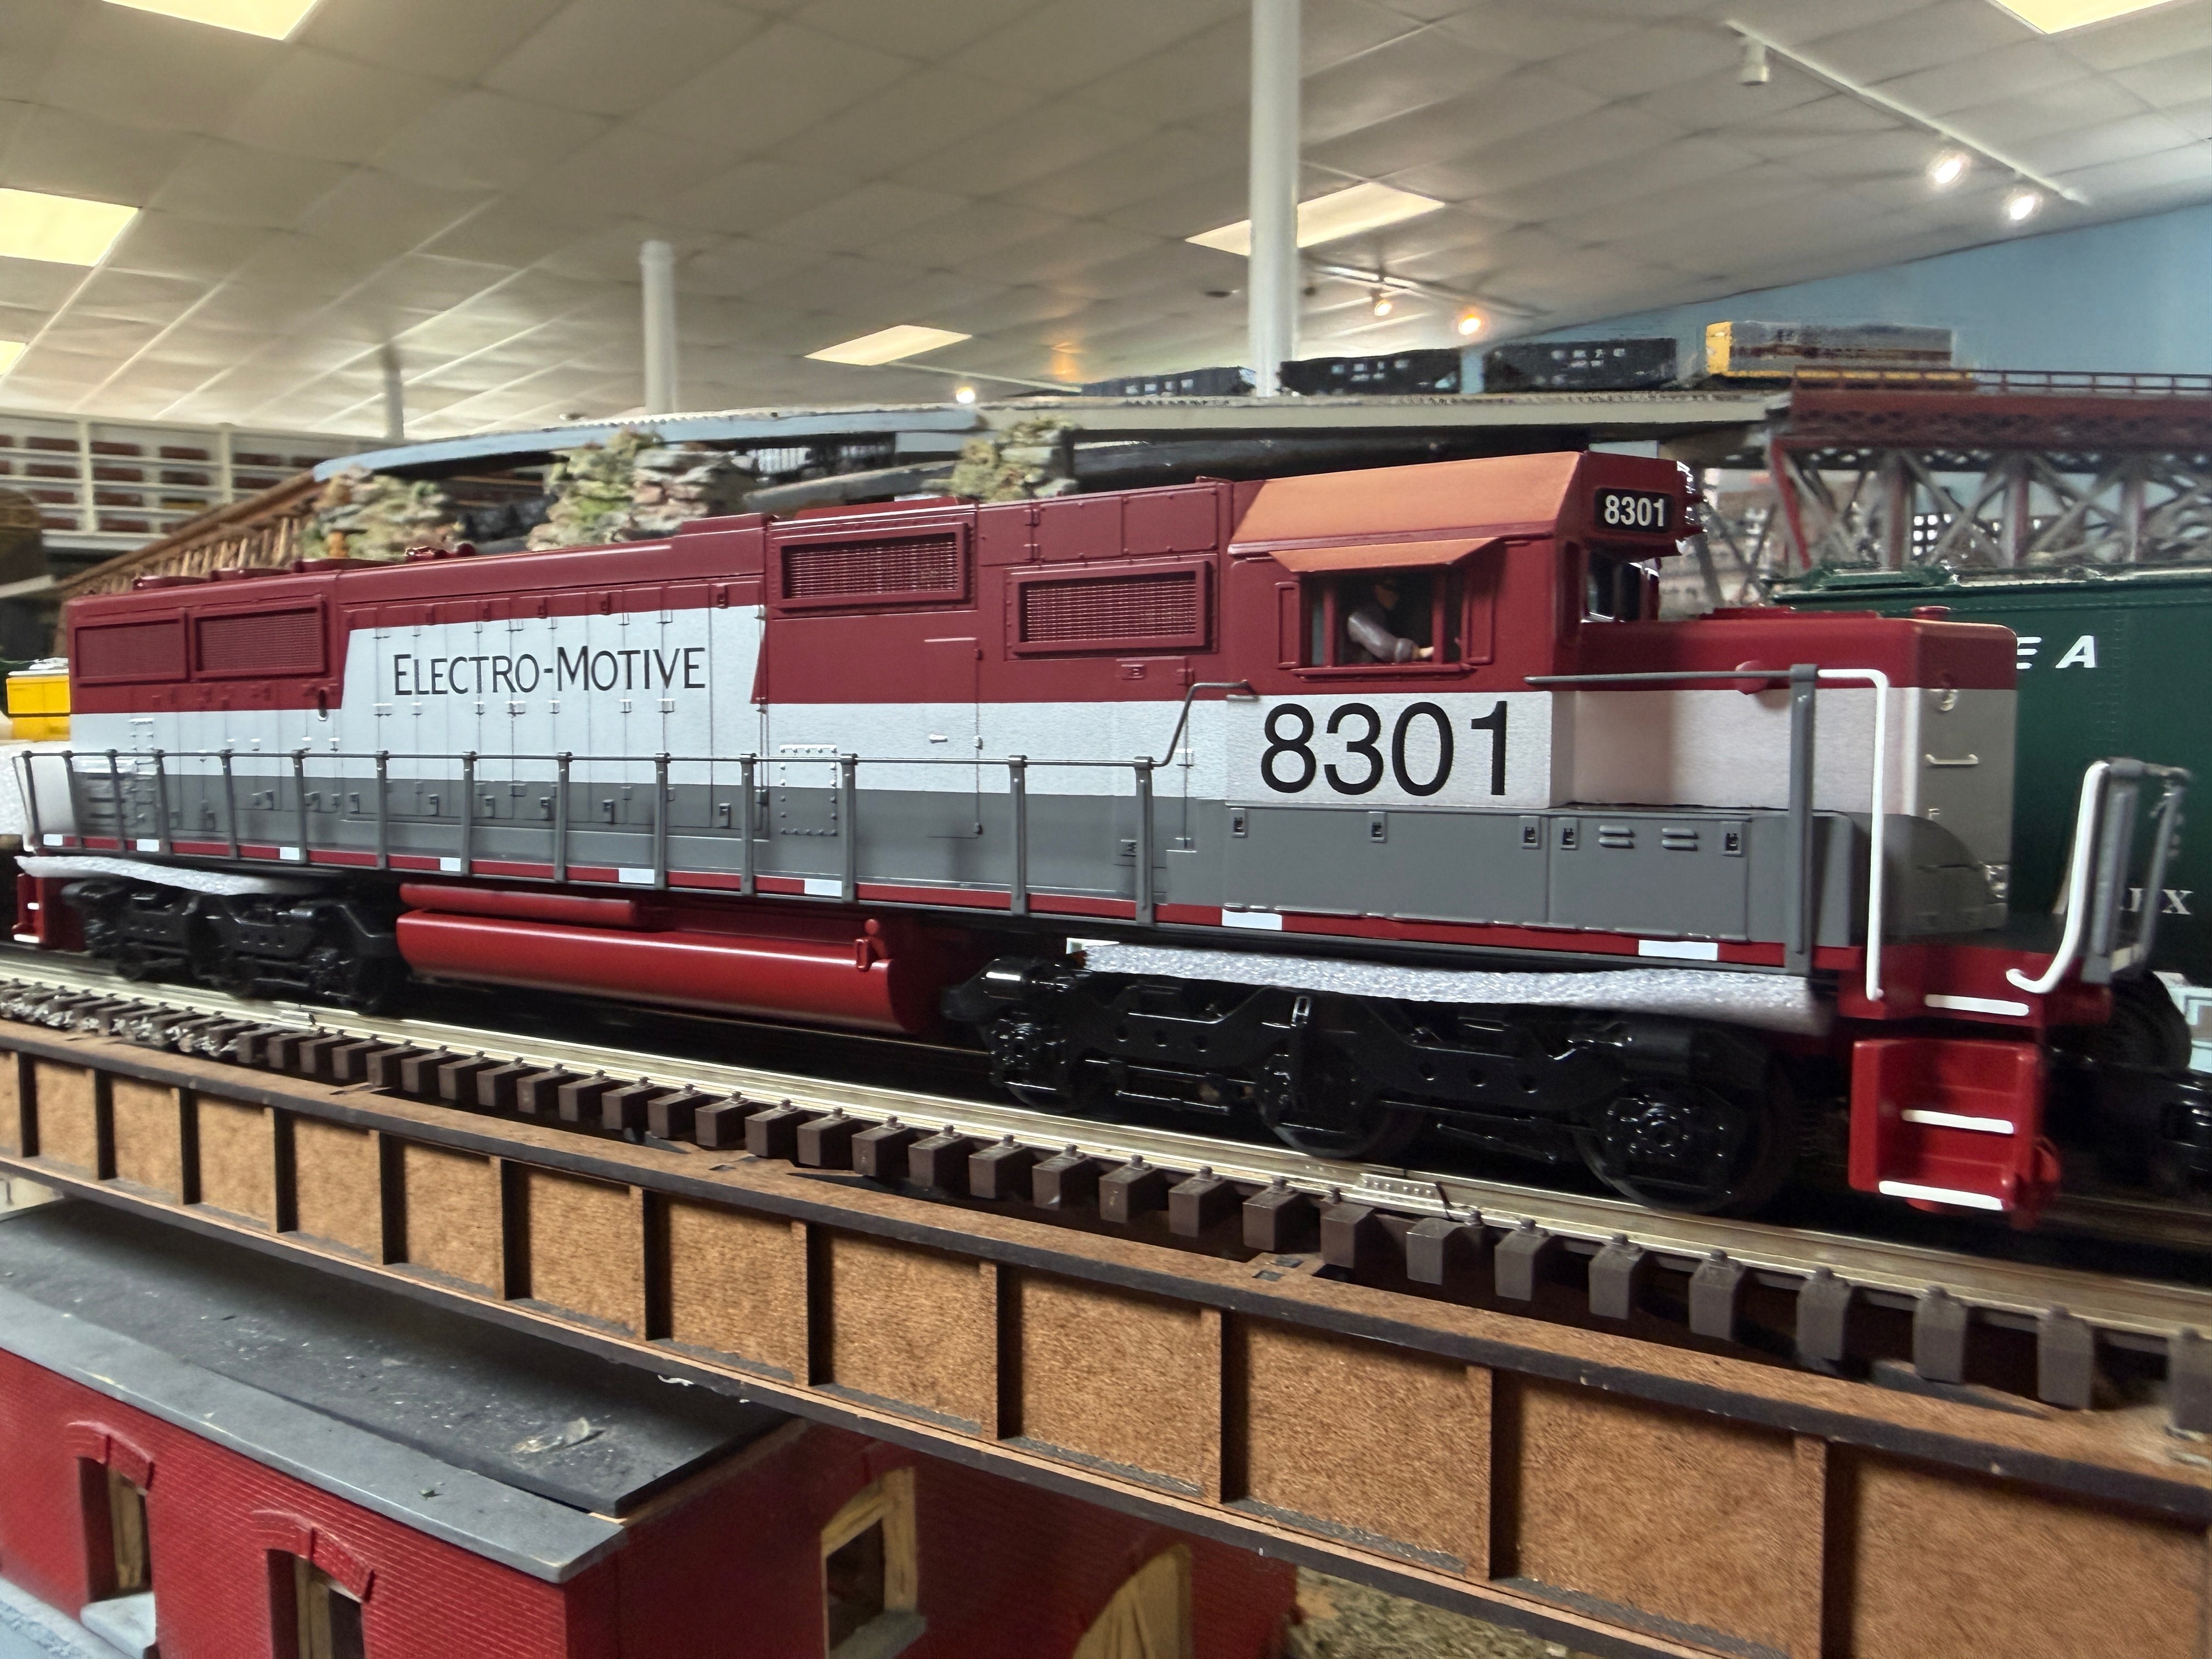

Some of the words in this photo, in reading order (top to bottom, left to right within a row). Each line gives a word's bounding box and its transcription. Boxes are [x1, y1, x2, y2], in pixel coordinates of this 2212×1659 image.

[1604, 495, 1664, 527] 8301
[393, 646, 706, 696] ELECTRO-MOTIVE
[1261, 700, 1507, 796] 8301
